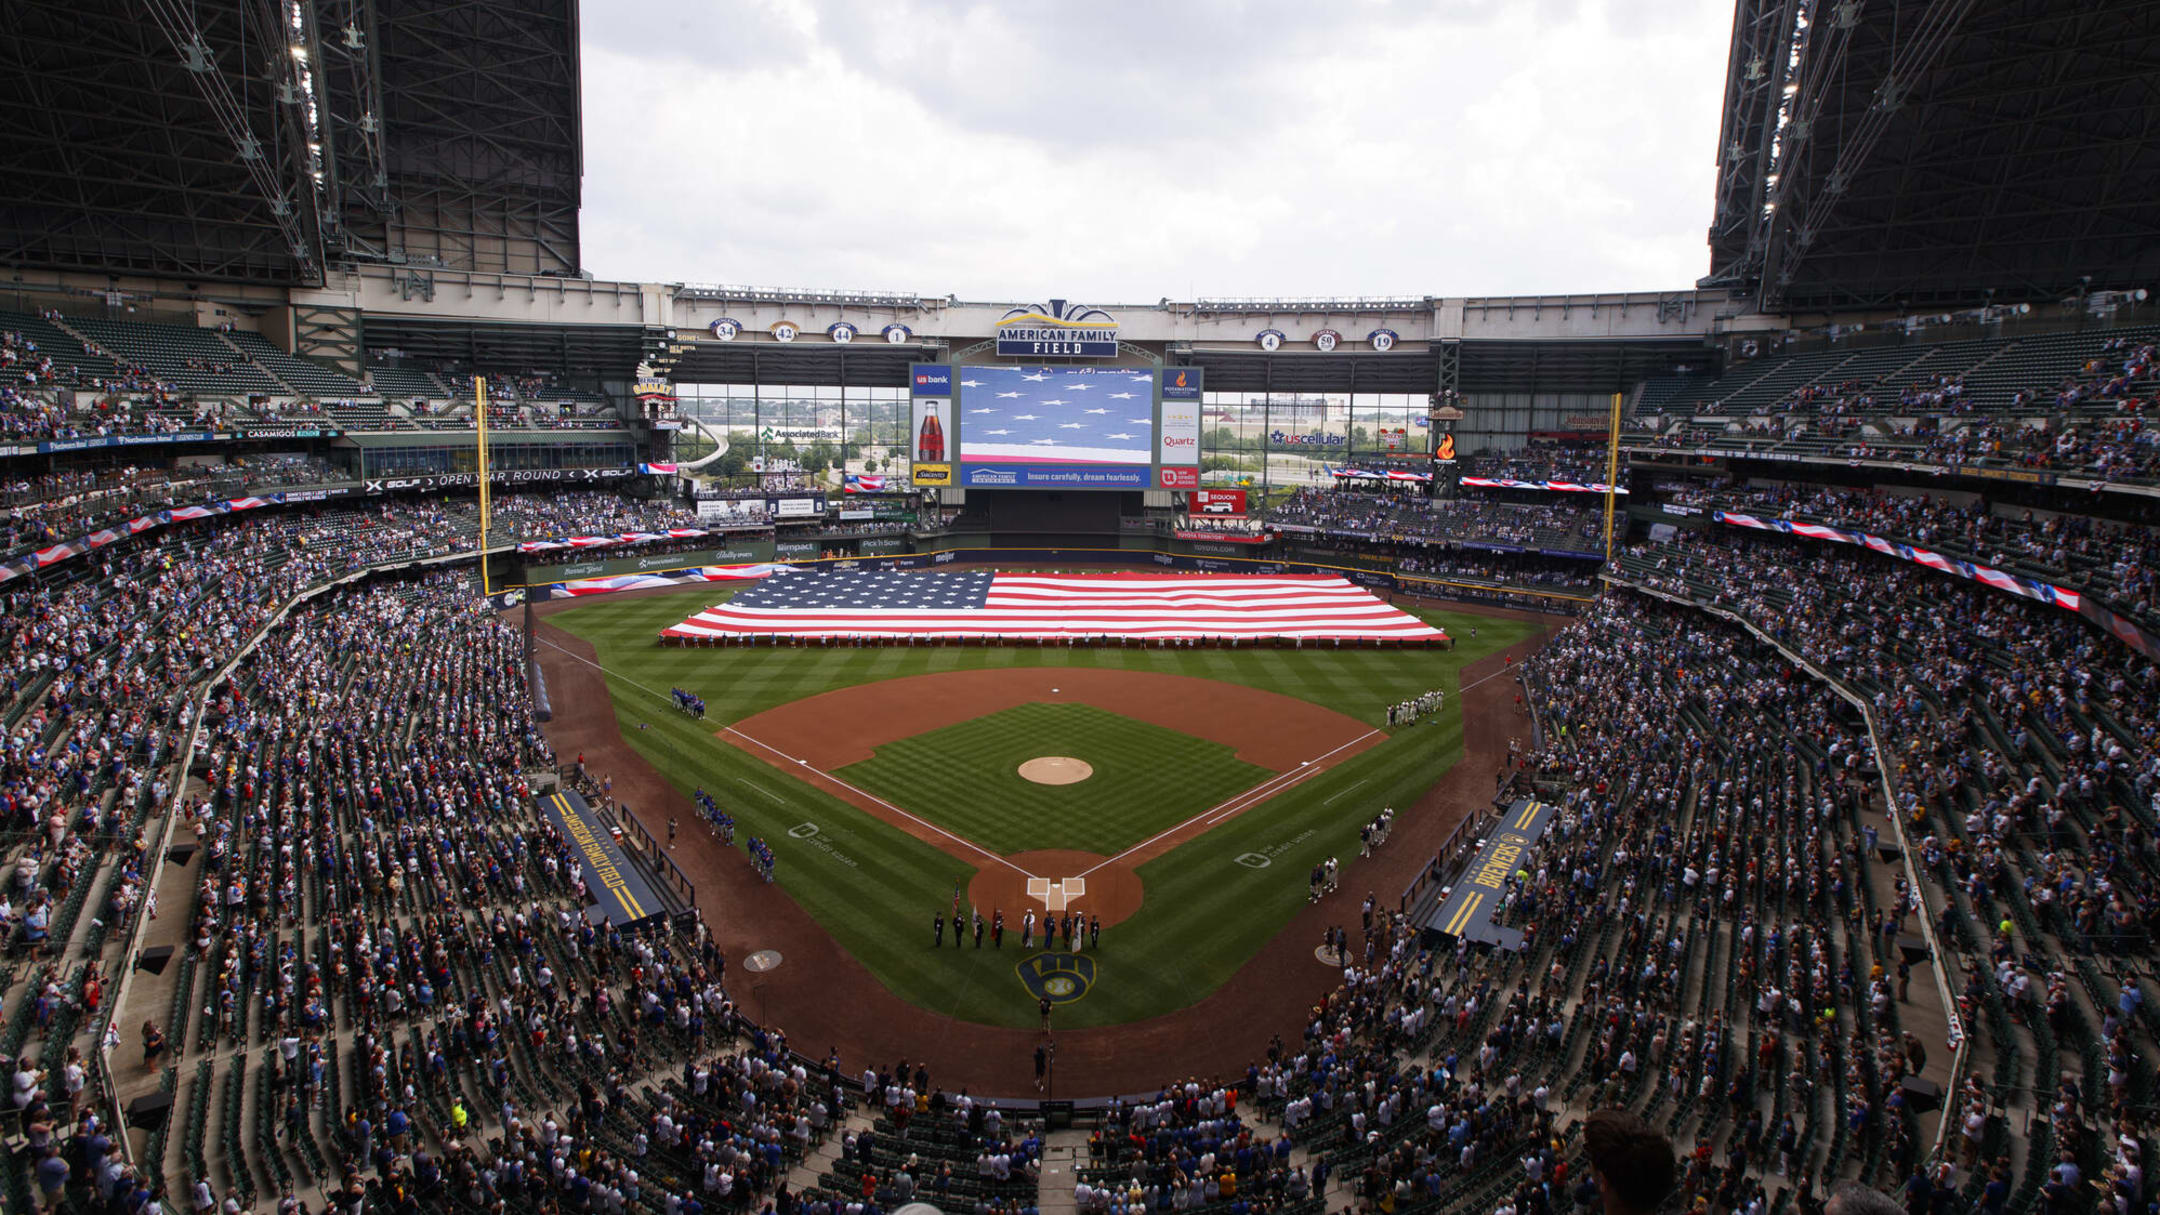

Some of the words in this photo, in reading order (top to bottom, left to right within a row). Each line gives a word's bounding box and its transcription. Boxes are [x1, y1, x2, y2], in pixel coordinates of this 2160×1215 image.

[719, 326, 734, 337] 34
[777, 329, 792, 339] 42
[835, 329, 850, 340] 44
[894, 332, 900, 342] 1
[999, 329, 1066, 341] AMERICAN
[1071, 330, 1117, 342] FAMILY
[1266, 337, 1274, 348] 4
[1320, 336, 1332, 345] 50
[1377, 337, 1390, 347] 19
[1033, 342, 1082, 354] FIELD
[928, 375, 949, 383] bank
[247, 430, 296, 438] CASAMIGOS
[775, 429, 821, 438] Associated
[821, 429, 840, 438] Bank
[1163, 435, 1196, 448] Quartz
[439, 474, 472, 486] OPEN
[475, 472, 507, 482] YAR
[513, 470, 561, 481] ROUND
[601, 469, 633, 477] GOLF
[1027, 472, 1050, 481] Insure
[1083, 473, 1105, 481] dream
[1106, 473, 1142, 482] fearlessly.
[386, 478, 421, 489] GOLF
[561, 813, 596, 846] AMERICAN
[580, 842, 612, 869] FAMILY
[596, 865, 626, 889] FIELD
[1474, 842, 1523, 890] BREWERS
